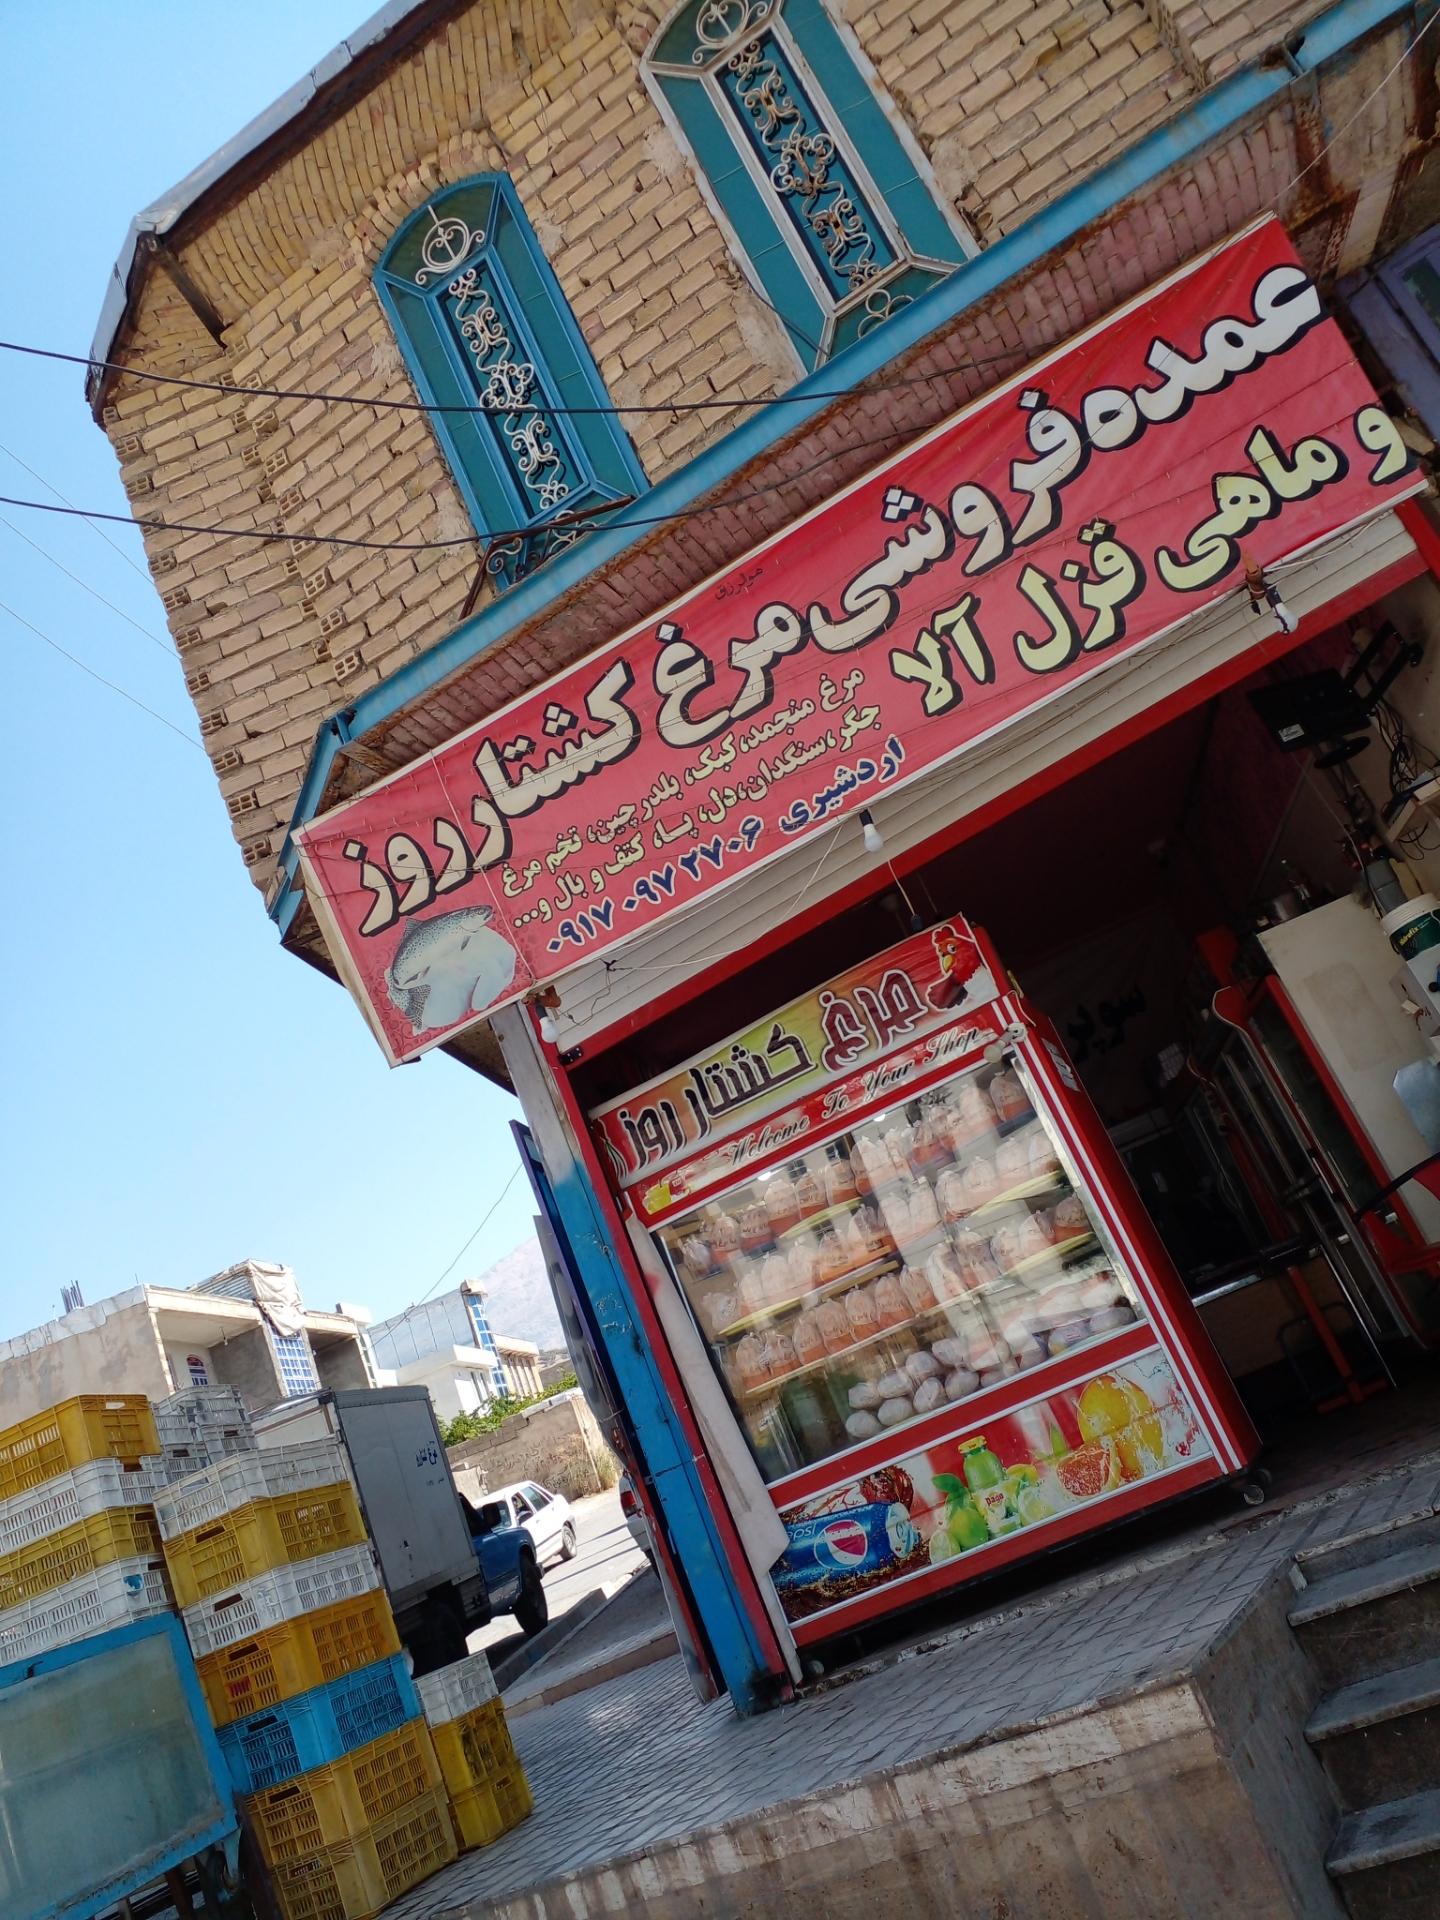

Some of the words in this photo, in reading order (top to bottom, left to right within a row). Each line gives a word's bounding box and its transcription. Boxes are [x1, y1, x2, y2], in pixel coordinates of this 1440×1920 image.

[1354, 404, 1414, 484] و
[1154, 424, 1349, 590] ماهی
[1012, 519, 1146, 674] قزل
[653, 601, 804, 748] مرغ
[819, 668, 865, 712] مرغ
[890, 593, 995, 716] آلا
[684, 732, 737, 786] کبک،
[738, 698, 816, 753] منجمد،
[840, 704, 881, 751] جگر
[472, 656, 642, 872] کشتار
[343, 817, 474, 936] روز
[502, 860, 543, 897] مرغ
[545, 826, 583, 874] تخم
[590, 868, 605, 893] و
[604, 831, 645, 875] کتف
[546, 896, 614, 953] ۰۹۱۷
[554, 871, 589, 911] بال
[816, 967, 928, 1075] مرغ
[682, 1021, 817, 1141] کشتار
[727, 1114, 811, 1167] Welcome
[821, 1087, 851, 1118] To
[861, 1060, 914, 1103] Your
[926, 1024, 984, 1063] Shop
[618, 1097, 688, 1171] روز
